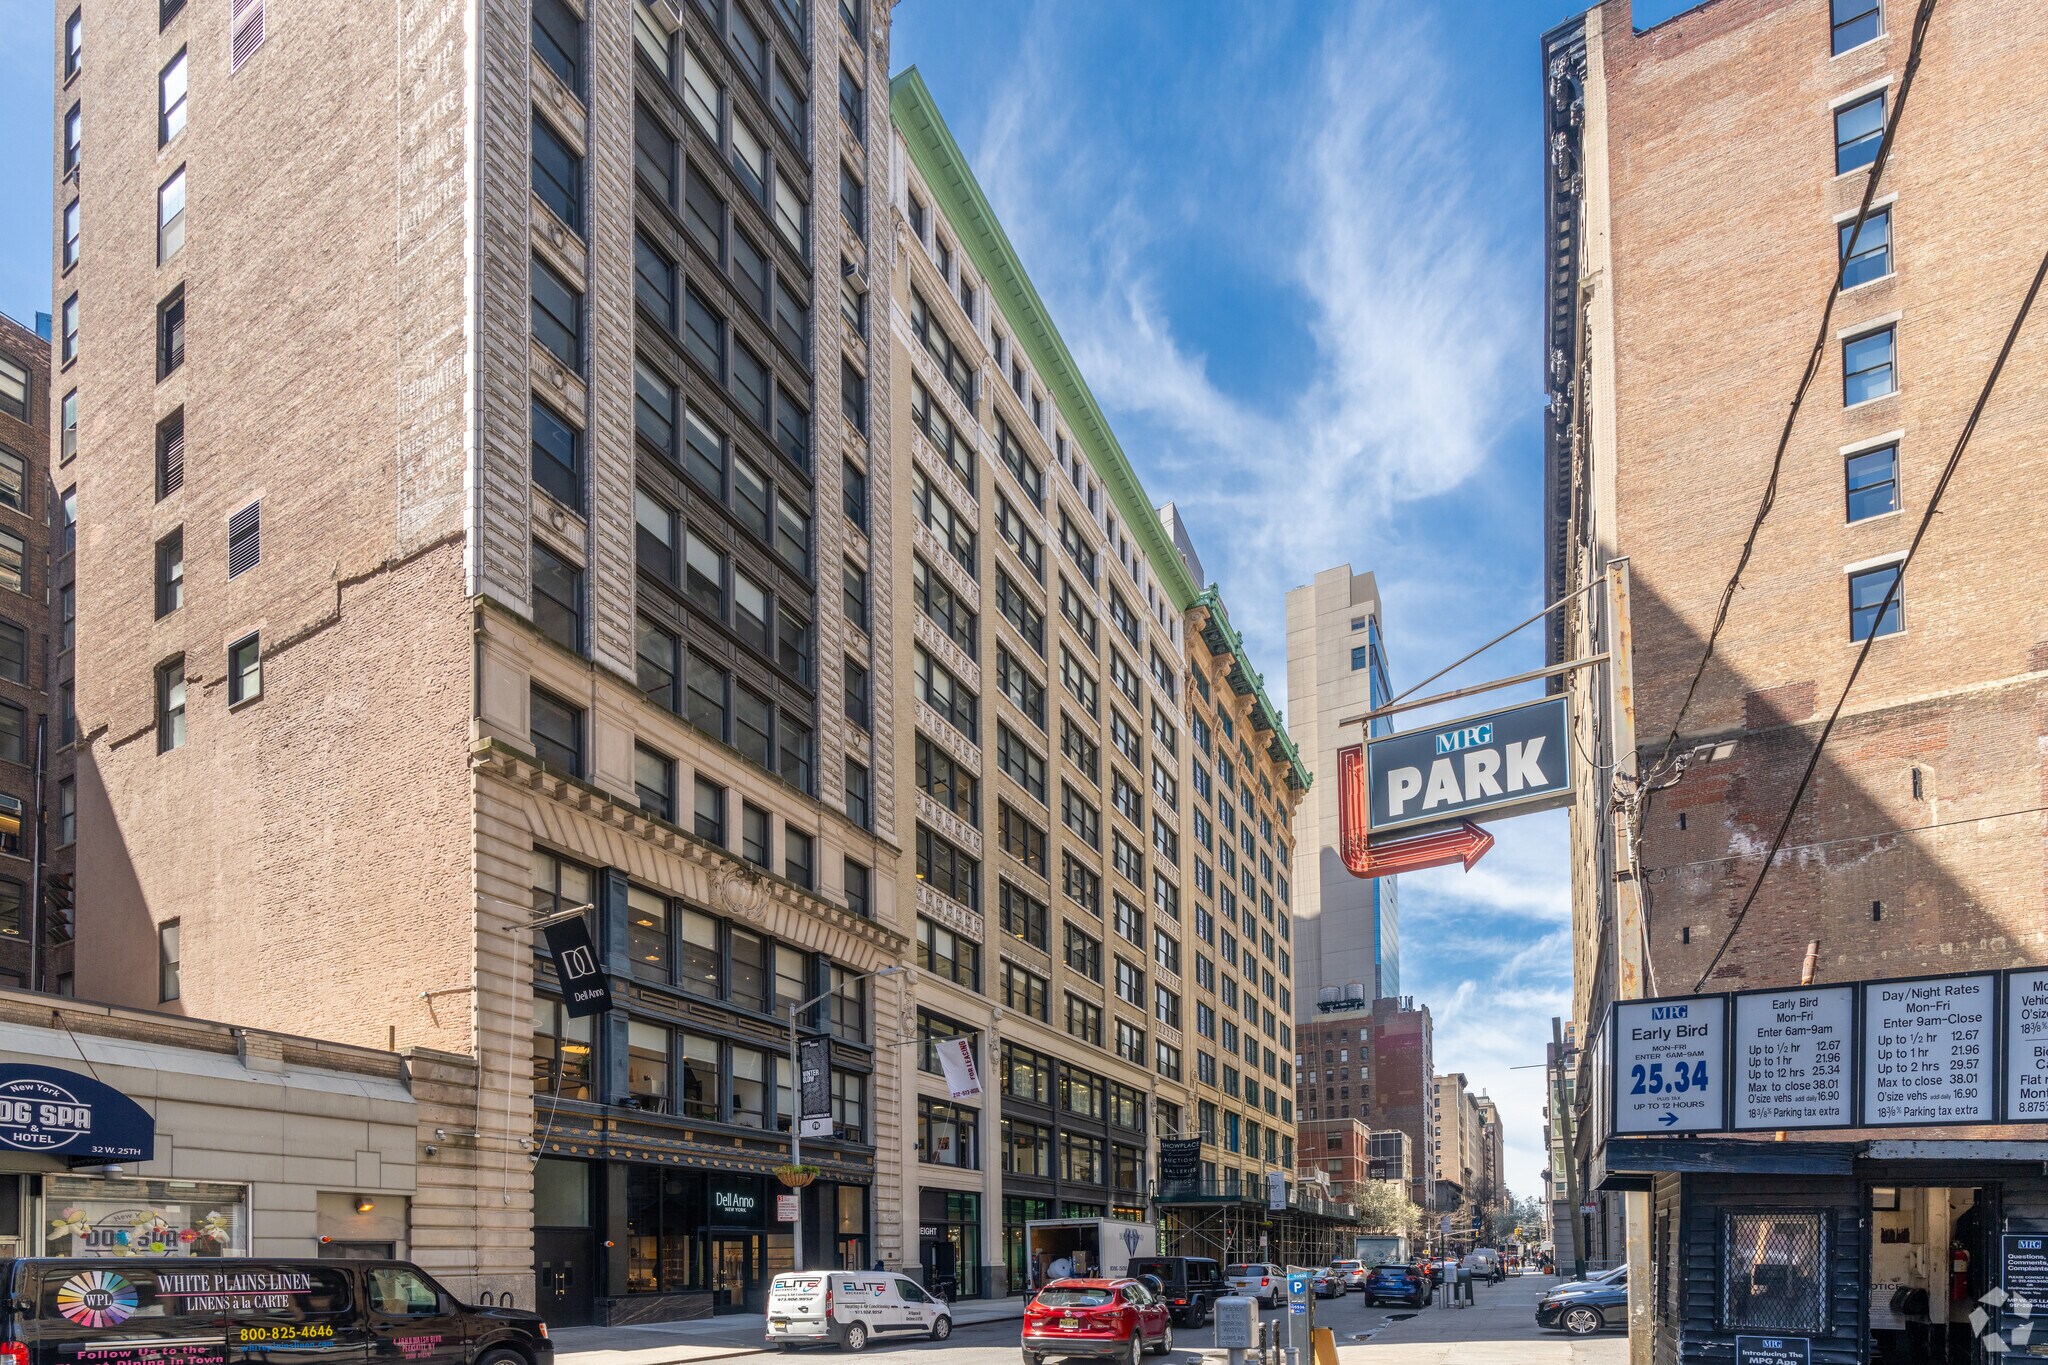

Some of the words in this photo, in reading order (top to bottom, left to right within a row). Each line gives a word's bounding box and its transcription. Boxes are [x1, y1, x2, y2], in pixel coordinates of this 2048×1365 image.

[1438, 724, 1492, 754] MPG
[1388, 736, 1549, 817] PARK
[574, 991, 588, 1002] Dell
[589, 988, 604, 999] Anno
[1882, 987, 1940, 1001] Day/Night
[1945, 985, 1979, 995] Rates
[1772, 1000, 1795, 1010] Early
[1800, 997, 1818, 1008] Bird
[1906, 1001, 1950, 1013] Mon-Fri
[1653, 1005, 1688, 1020] MPG
[1776, 1011, 1813, 1023] Mon-Fri
[1884, 1019, 1913, 1029] Enter
[1916, 1013, 1982, 1026] 9am-Close
[1632, 1027, 1671, 1041] Early
[1676, 1024, 1708, 1038] Bird
[1758, 1028, 1782, 1038] Enter
[1785, 1025, 1832, 1036] 6am-9am
[1878, 1036, 1892, 1046] Up
[1896, 1035, 1906, 1044] to
[1926, 1033, 1937, 1042] hr
[1951, 1030, 1979, 1041] 12.67
[1652, 1044, 1687, 1052] MON-FRI
[1749, 1045, 1761, 1055] Up
[1764, 1045, 1774, 1054] to
[1791, 1043, 1800, 1052] hr
[1816, 1040, 1840, 1051] 12.67
[1878, 1050, 1892, 1061] Up
[1896, 1049, 1907, 1058] to
[1911, 1048, 1914, 1057] 1
[1918, 1048, 1928, 1057] hr
[1951, 1045, 1979, 1056] 21.96
[1749, 1058, 1761, 1068] Up
[1764, 1057, 1773, 1066] to
[1776, 1056, 1780, 1065] 1
[1783, 1056, 1792, 1065] hr
[1815, 1053, 1840, 1063] 21.96
[1878, 1064, 1892, 1075] Up
[1896, 1063, 1907, 1072] to
[1911, 1062, 1918, 1072] 2
[1922, 1062, 1939, 1071] hrs
[1950, 1059, 1979, 1070] 29.57
[1630, 1060, 1708, 1095] 25.34
[1748, 1070, 1761, 1080] Up
[1764, 1069, 1774, 1078] to
[1777, 1068, 1786, 1078] 12
[1790, 1068, 1804, 1077] hrs
[1812, 1065, 1840, 1076] 25.34
[1748, 1083, 1767, 1092] Max
[1772, 1082, 1781, 1091] to
[1785, 1081, 1811, 1091] close
[1813, 1079, 1839, 1090] 38.01
[1877, 1078, 1897, 1087] Max
[1902, 1077, 1912, 1087] to
[1915, 1076, 1942, 1086] close
[1949, 1073, 1977, 1084] 38.01
[2021, 1075, 2041, 1085] Flat
[10, 1084, 34, 1092] New
[36, 1084, 60, 1097] York
[1748, 1094, 1771, 1104] O'size
[1774, 1093, 1792, 1103] vehs
[1817, 1091, 1839, 1101] 16.90
[1877, 1092, 1904, 1102] O'size
[1907, 1091, 1927, 1100] vehs
[1953, 1088, 1977, 1098] 16.90
[1673, 1101, 1705, 1109] HOURS
[1774, 1108, 1802, 1118] Parking
[1804, 1107, 1817, 1116] tax
[1819, 1106, 1839, 1116] extra
[1904, 1106, 1935, 1118] Parking
[1938, 1105, 1952, 1115] tax
[1955, 1105, 1978, 1115] extra
[40, 1104, 91, 1129] SPA
[13, 1133, 55, 1143] HOTEL
[1162, 1141, 1199, 1149] SHOWPLACE
[105, 1146, 115, 1154] W.
[716, 1192, 731, 1206] Dell
[732, 1193, 754, 1208] Anno
[2020, 1240, 2040, 1249] MPG
[157, 1275, 210, 1293] WHITE
[214, 1274, 266, 1292] PLAINS
[268, 1273, 311, 1291] LINEN
[1294, 1282, 1302, 1293] P
[85, 1294, 113, 1306] WPL
[187, 1297, 230, 1311] LINENS
[241, 1296, 251, 1309] la
[254, 1295, 289, 1308] CARTE
[240, 1325, 333, 1341] 800-825-4646
[1764, 1340, 1781, 1348] MPG
[77, 1350, 132, 1360] Follow
[138, 1348, 157, 1357] Us
[162, 1346, 177, 1355] to
[183, 1345, 206, 1354] the
[1742, 1350, 1787, 1358] Introducing
[170, 1357, 184, 1365] in
[187, 1356, 223, 1365] Town
